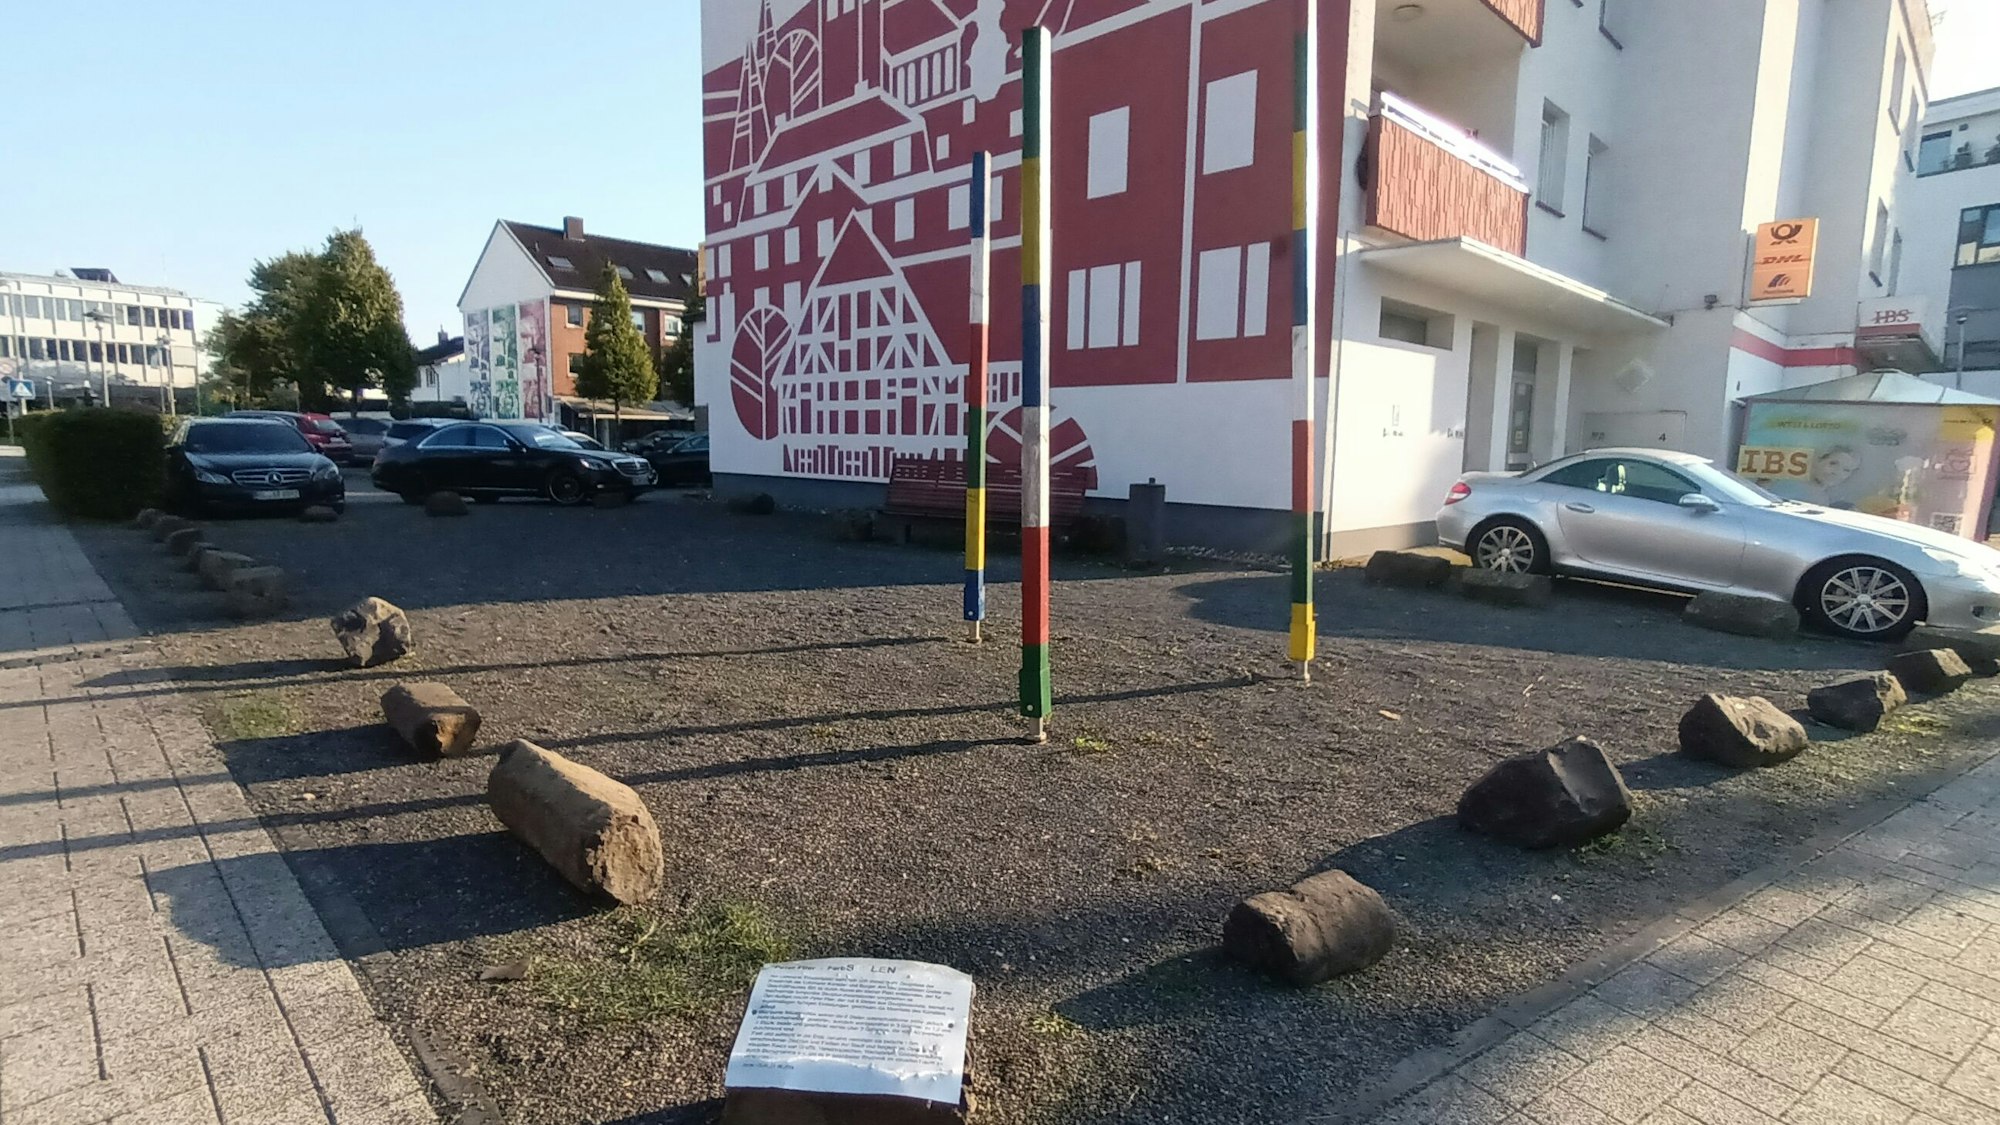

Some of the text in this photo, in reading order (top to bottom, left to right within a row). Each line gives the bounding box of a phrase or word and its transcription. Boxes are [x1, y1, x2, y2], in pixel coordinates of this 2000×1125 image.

[1762, 255, 1803, 265] DHL
[1659, 433, 1666, 441] 4
[1741, 449, 1808, 476] IBS
[870, 964, 897, 974] LEN
